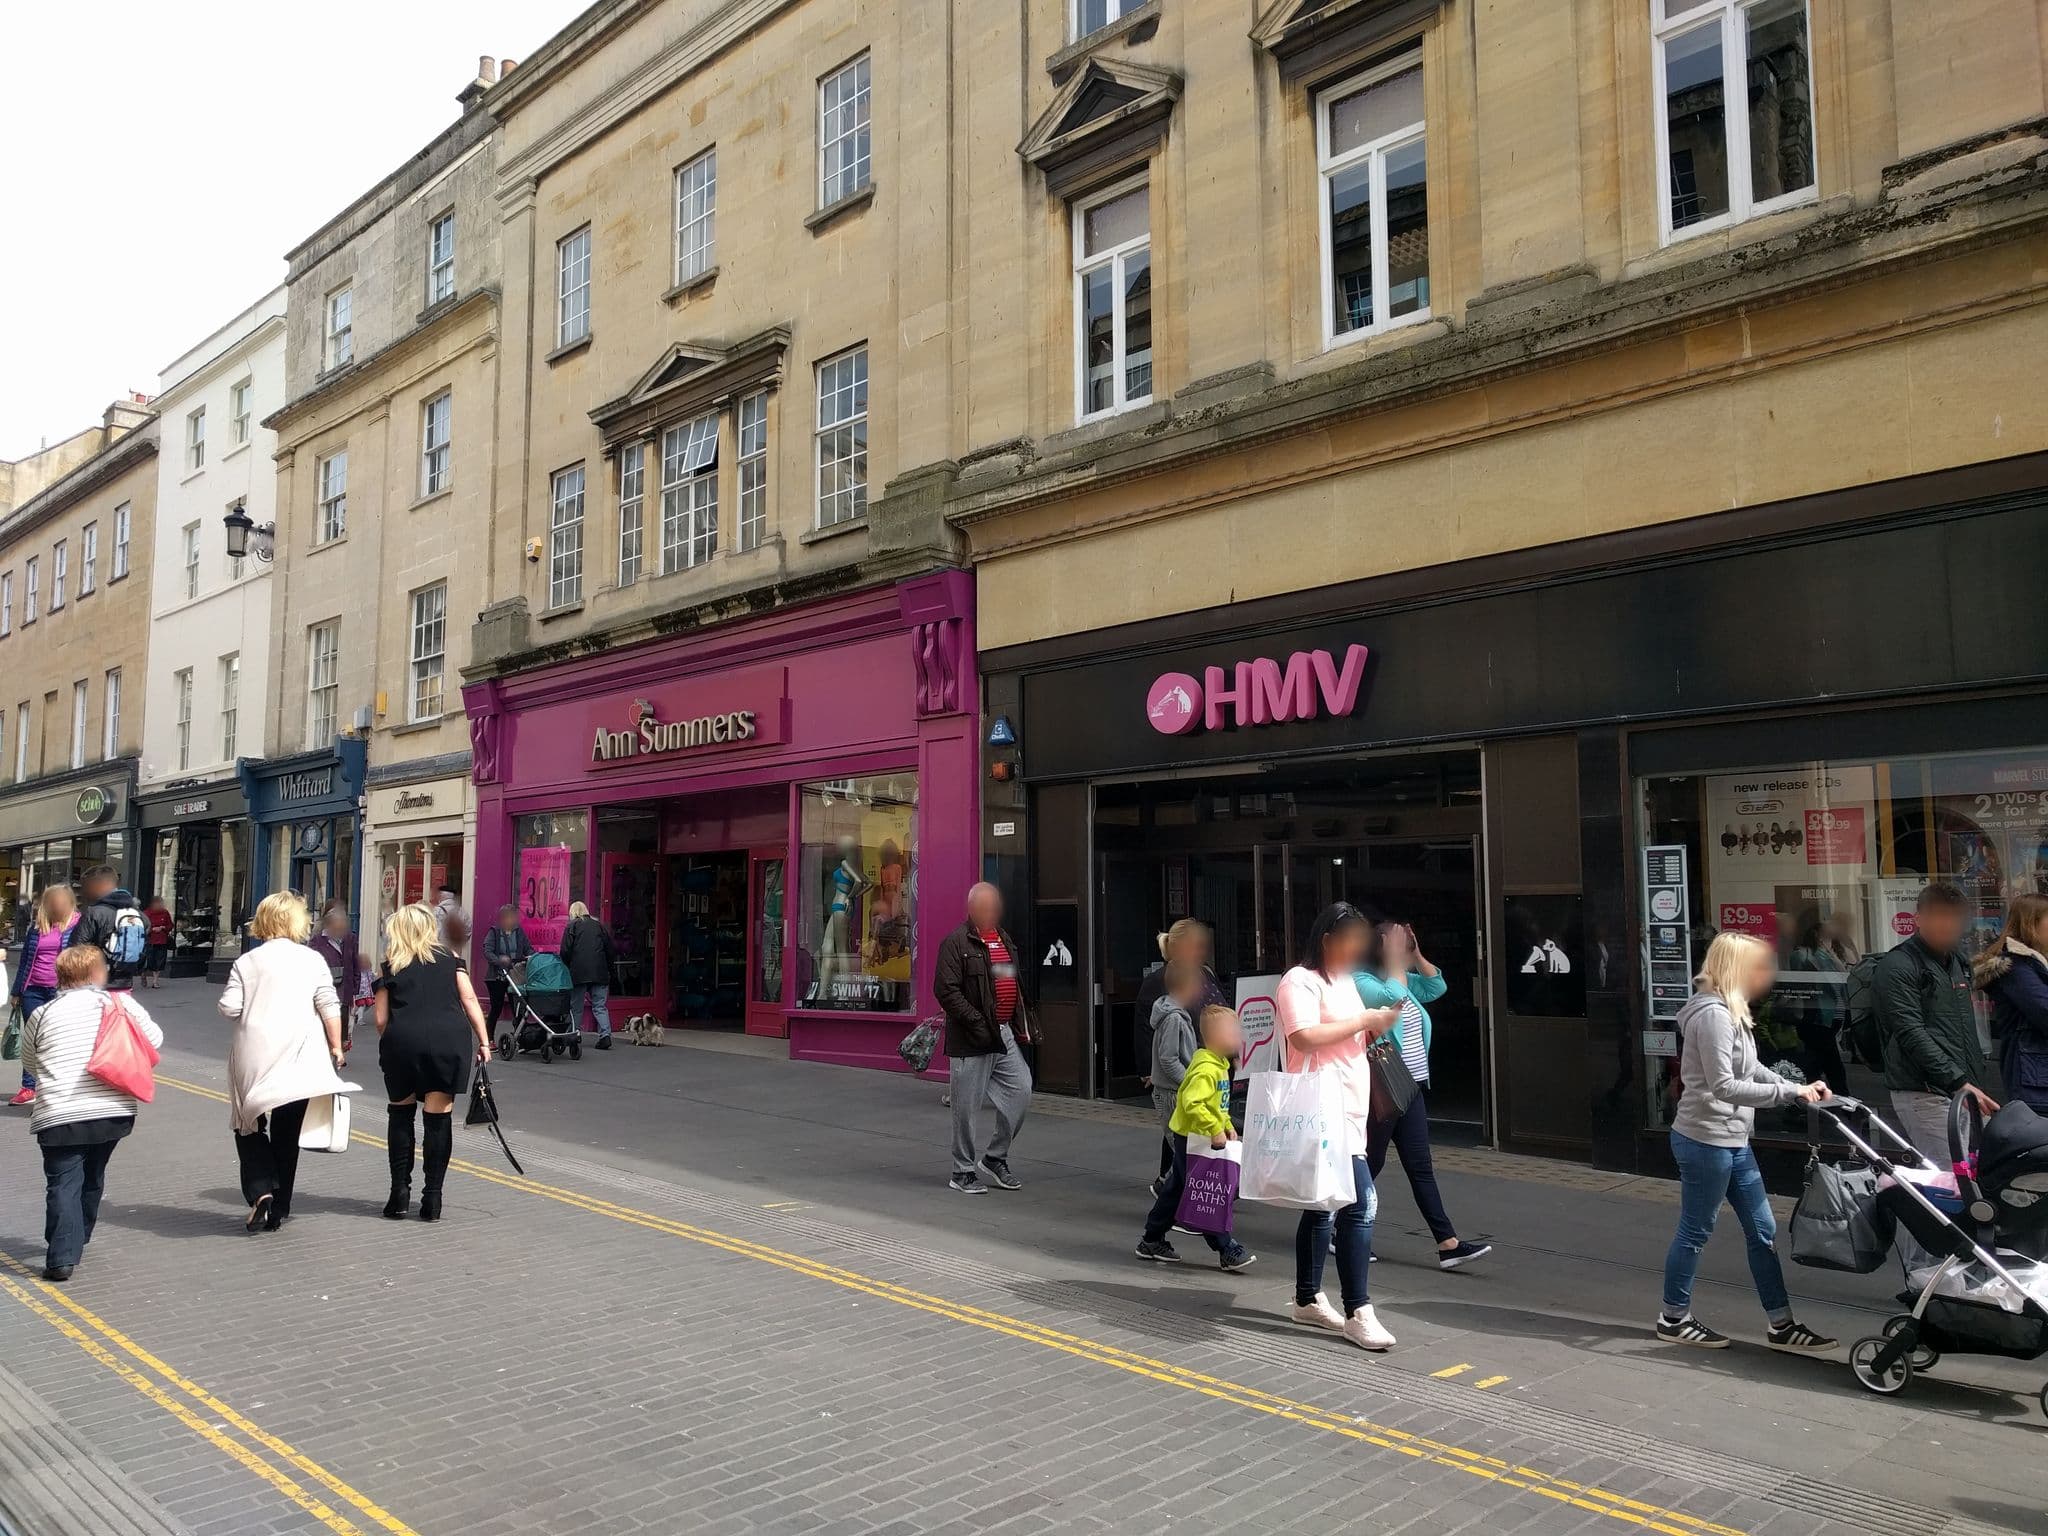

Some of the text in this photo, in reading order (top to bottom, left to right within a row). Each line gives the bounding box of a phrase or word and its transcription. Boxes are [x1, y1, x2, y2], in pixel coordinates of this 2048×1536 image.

[1204, 643, 1369, 730] HMV
[591, 709, 756, 762] Ann Summers
[278, 766, 333, 801] Whittard
[1733, 783, 1759, 793] new
[1763, 780, 1809, 792] release
[79, 794, 101, 813] schuh
[393, 790, 435, 815] Thorntons
[1974, 794, 1994, 818] 2
[1995, 791, 2038, 805] DVDs
[2004, 804, 2027, 817] for
[1807, 812, 1850, 831] £9.99
[1979, 820, 2002, 829] more
[526, 876, 562, 919] 30%
[1722, 906, 1763, 925] £9.99
[831, 982, 881, 999] SWIM '17
[1205, 1170, 1220, 1180] THE
[1188, 1176, 1232, 1195] ROMAN
[1190, 1189, 1227, 1206] BATHS
[1196, 1203, 1216, 1215] BATH
